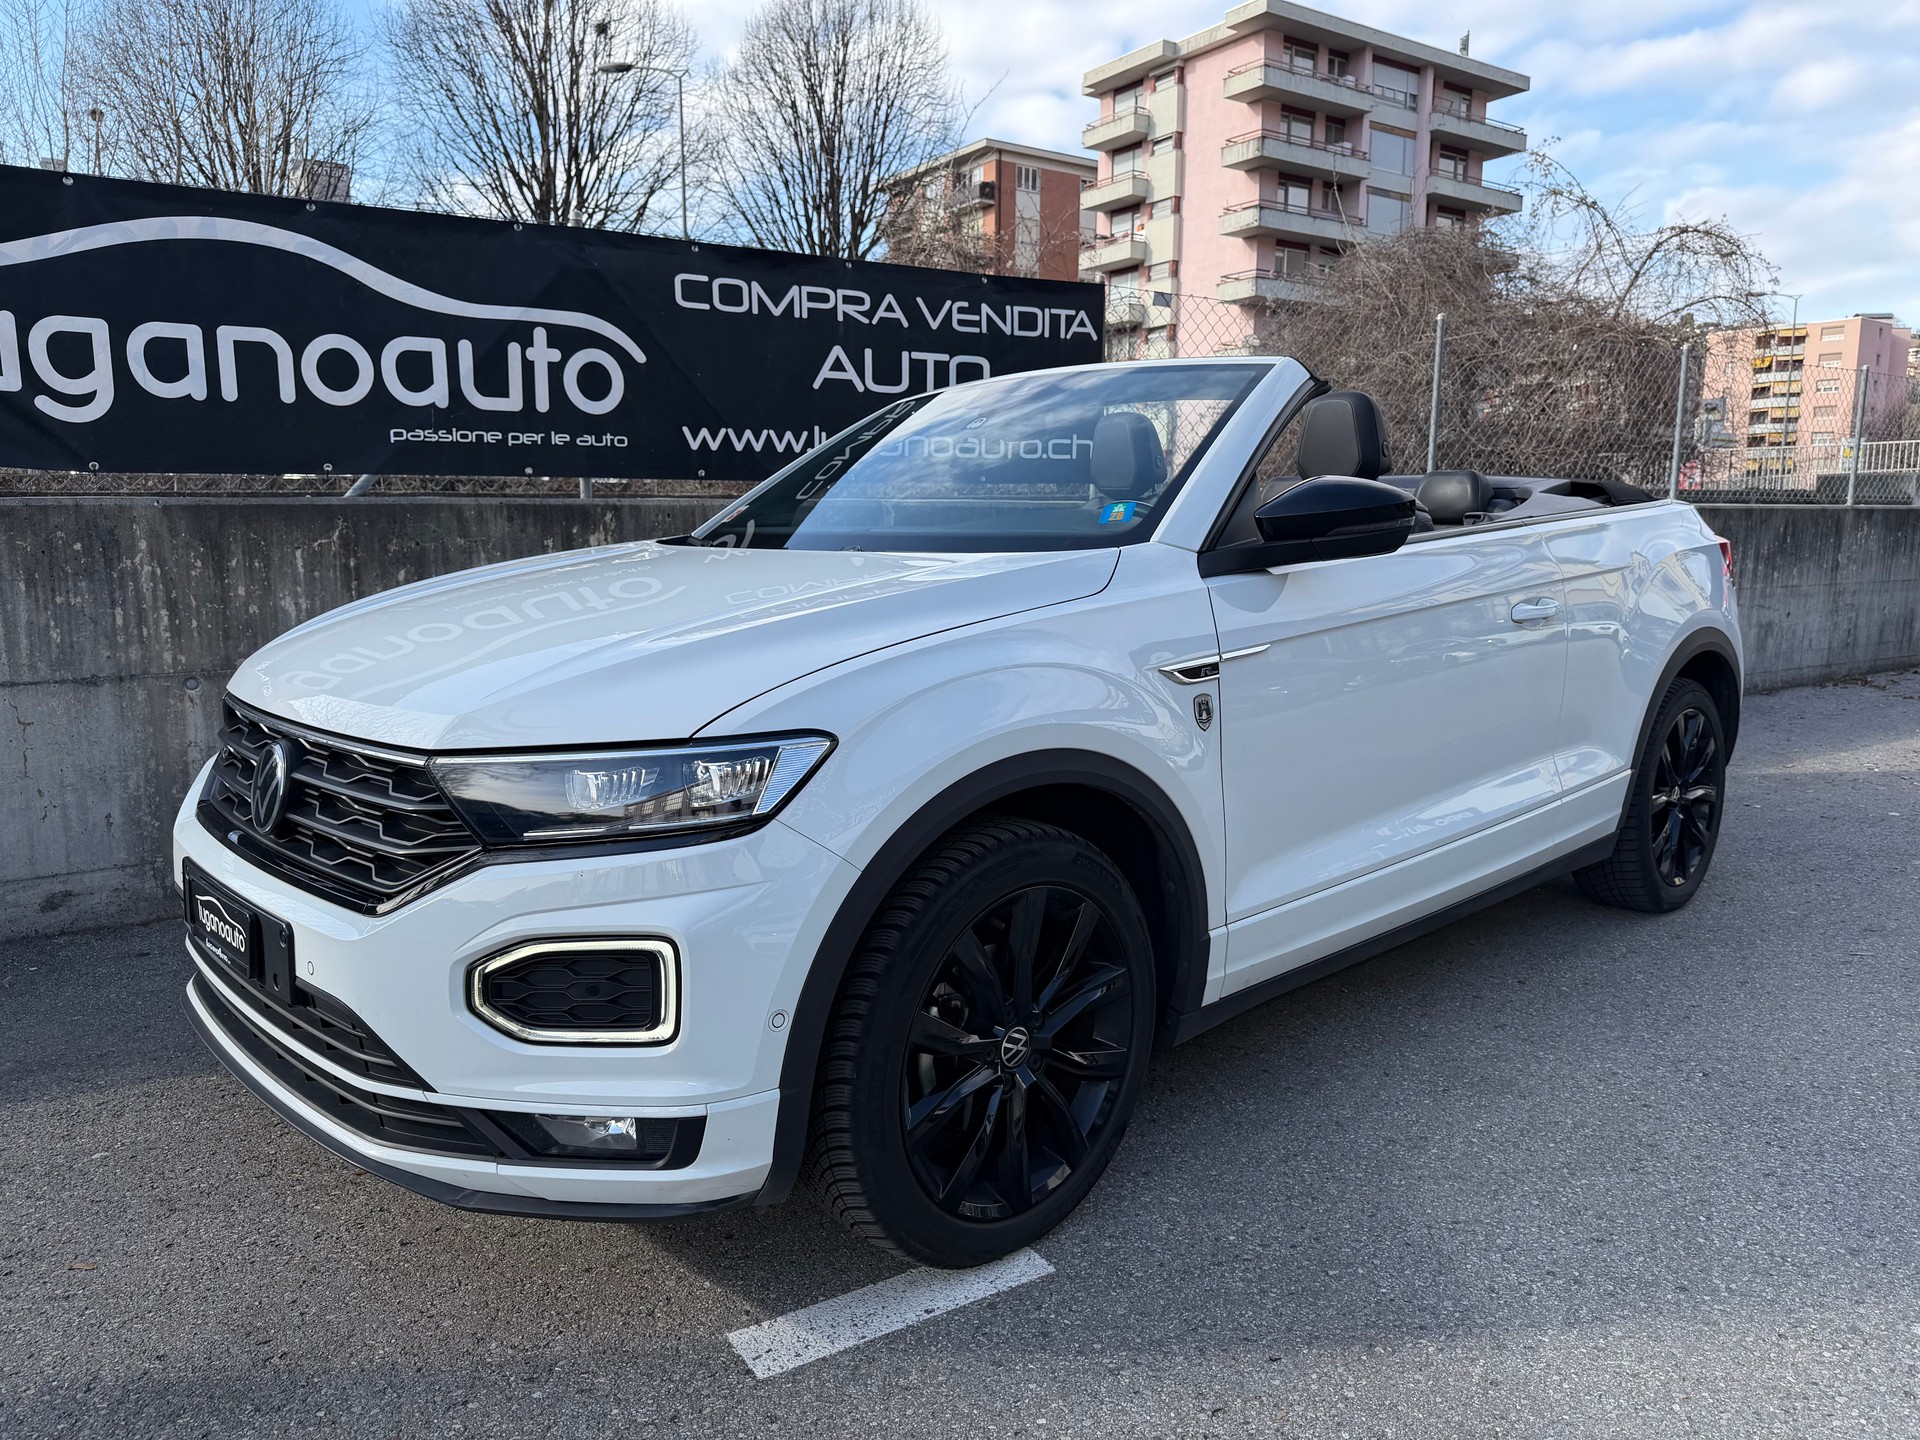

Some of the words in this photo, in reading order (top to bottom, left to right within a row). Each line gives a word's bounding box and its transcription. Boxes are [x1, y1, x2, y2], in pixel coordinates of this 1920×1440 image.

[674, 272, 909, 328] COMPRA
[916, 297, 1098, 342] VENDITA
[390, 427, 502, 443] passione
[508, 431, 545, 447] per
[551, 430, 570, 445] le
[576, 433, 628, 447] auto
[197, 899, 246, 953] luganoauto
